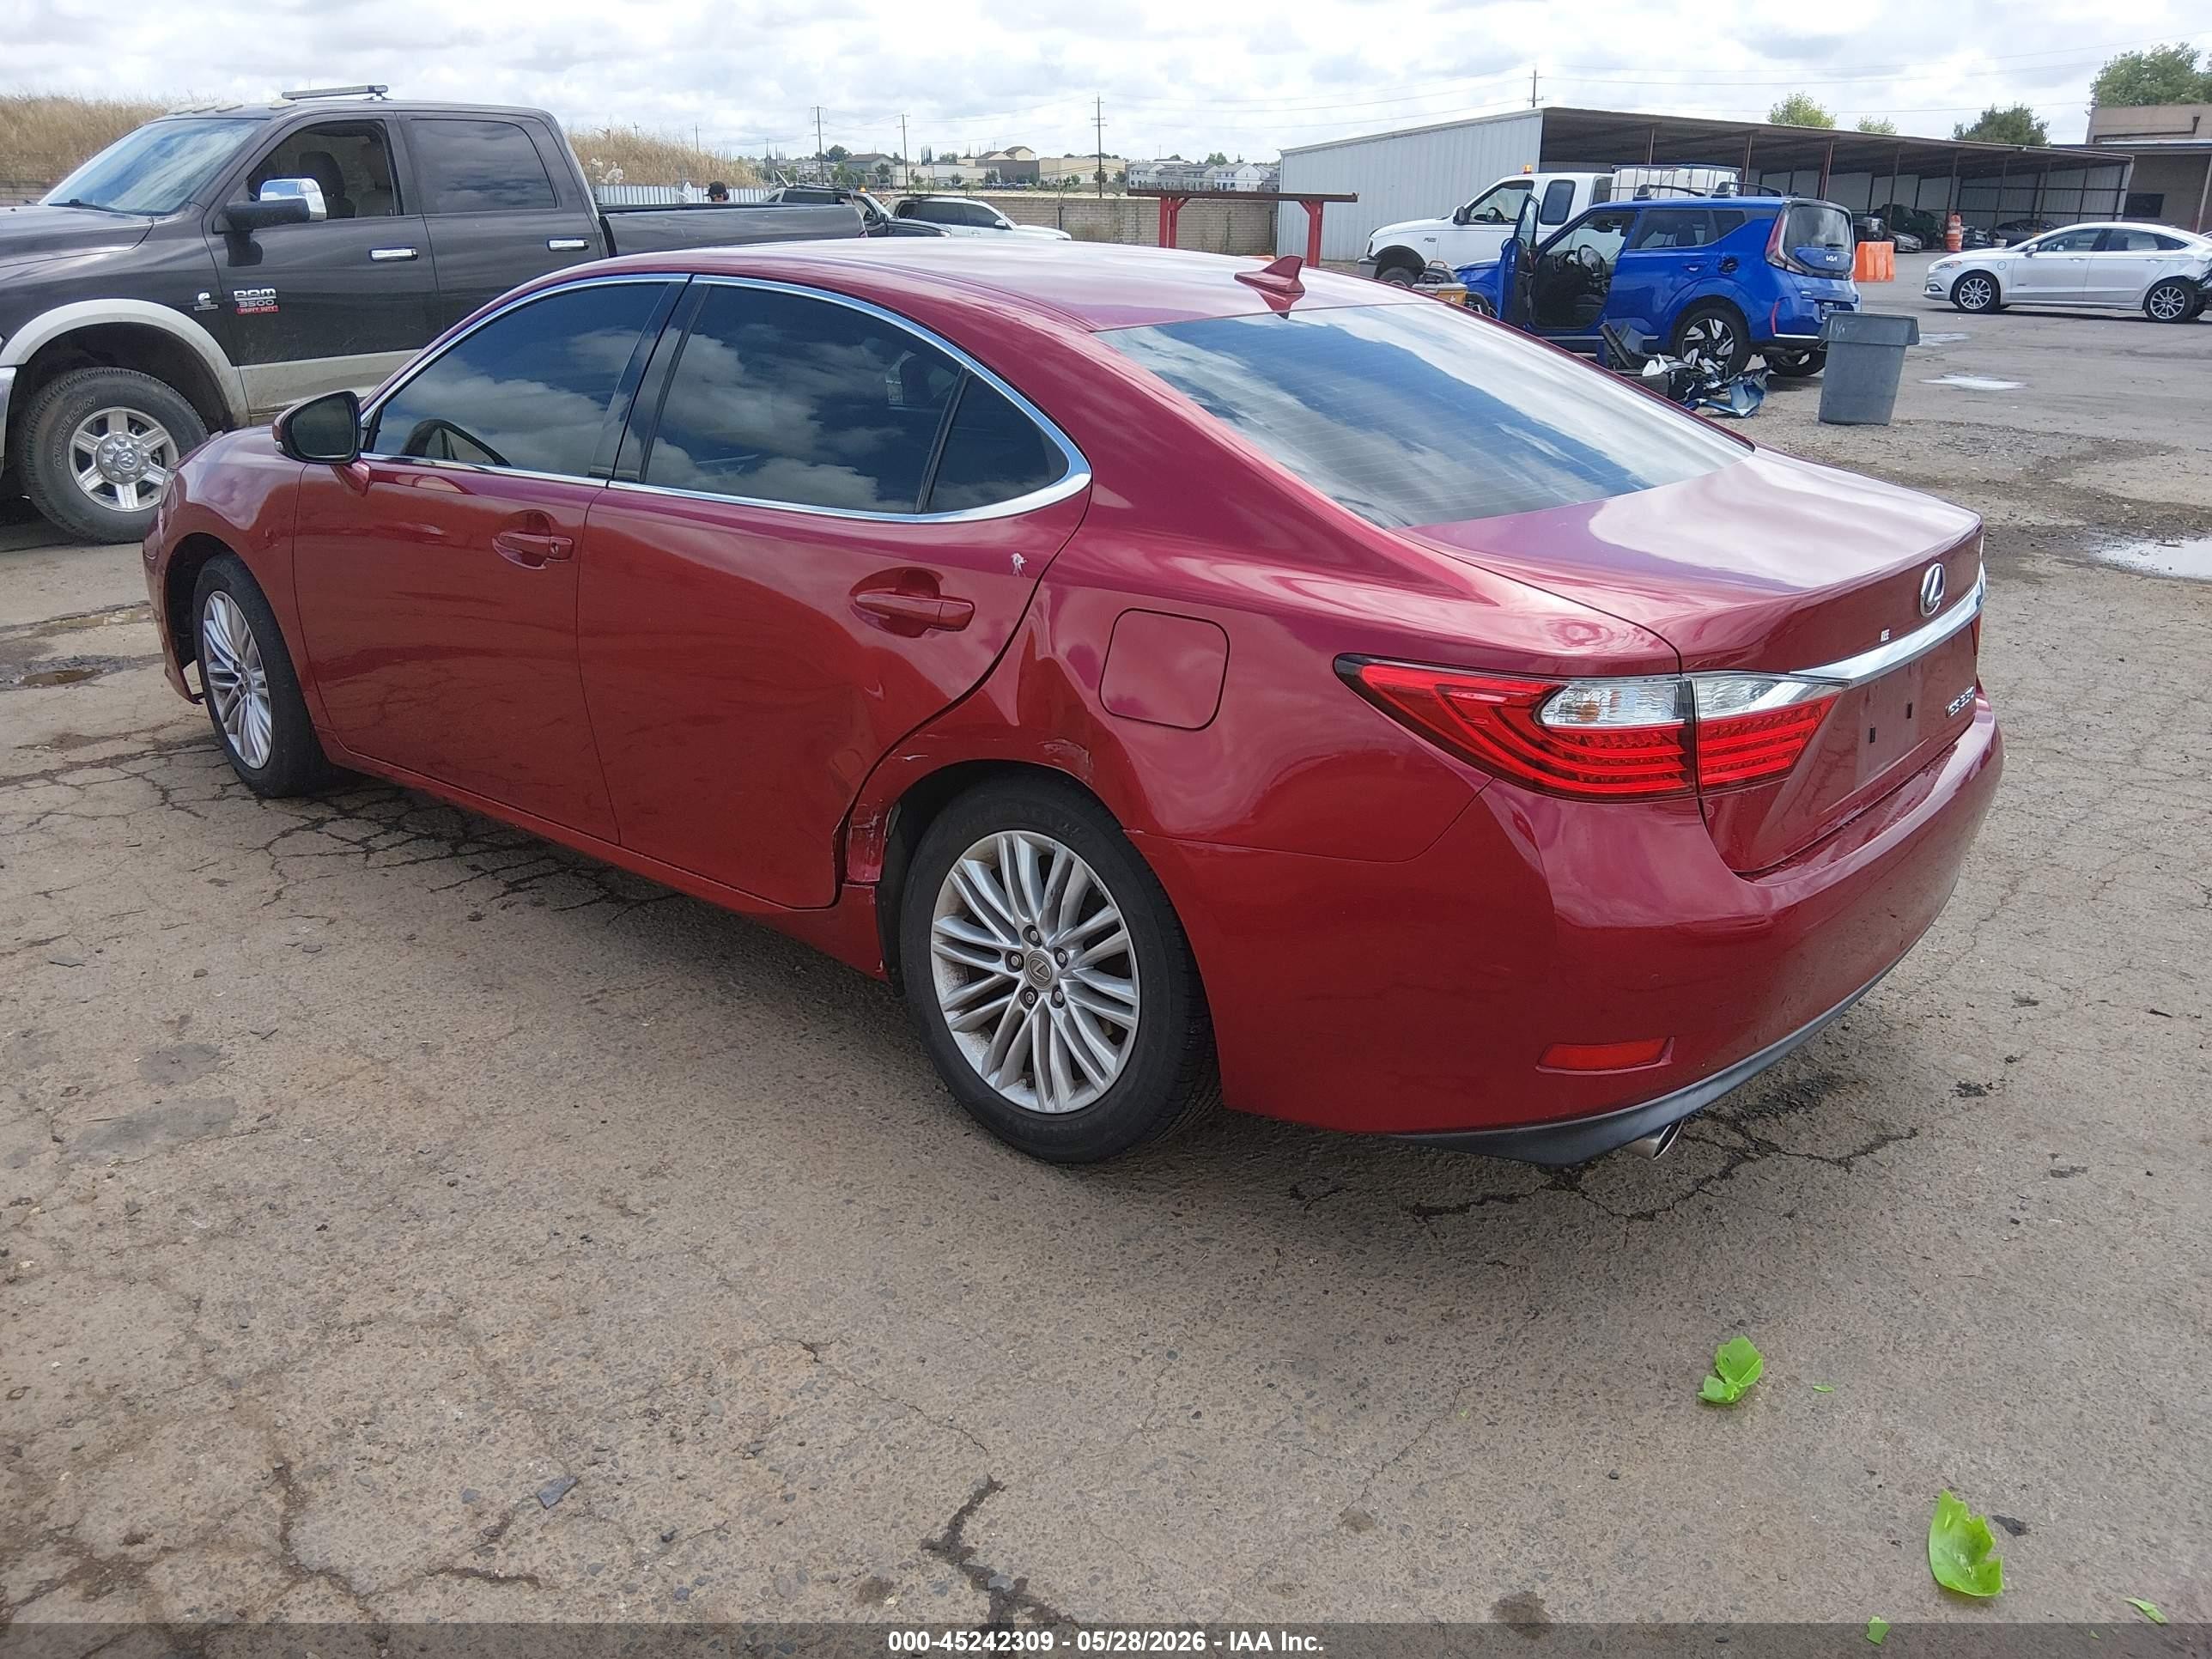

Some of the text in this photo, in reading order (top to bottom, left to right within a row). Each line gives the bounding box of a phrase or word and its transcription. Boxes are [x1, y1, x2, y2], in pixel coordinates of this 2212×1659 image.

[233, 288, 276, 301] RAM
[238, 299, 275, 307] 3500
[52, 398, 96, 469] MICHELIN
